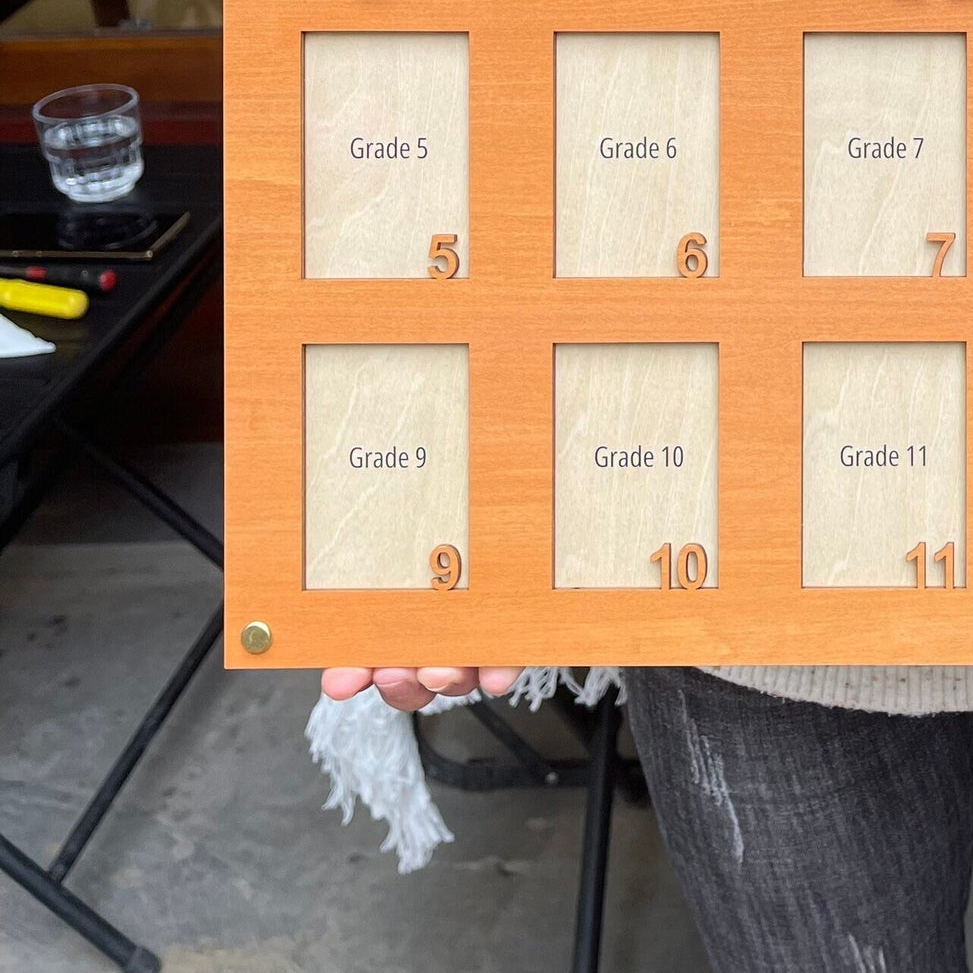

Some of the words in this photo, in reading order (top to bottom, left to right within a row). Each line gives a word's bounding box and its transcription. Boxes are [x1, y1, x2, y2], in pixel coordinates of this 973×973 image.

[350, 137, 411, 159] Grade
[416, 137, 428, 159] 5
[599, 137, 660, 159] Grade
[665, 137, 677, 159] 6
[847, 137, 907, 160] Grade
[913, 137, 924, 159] 7
[427, 233, 460, 279] 5
[676, 232, 708, 278] 6
[926, 232, 956, 277] 7
[349, 446, 409, 469] Grade
[415, 446, 427, 469] 9
[594, 445, 654, 468] Grade
[662, 445, 684, 468] 10
[840, 445, 900, 467] Grade
[907, 445, 928, 467] 11
[429, 544, 462, 590] 9
[649, 543, 708, 589] 10
[905, 542, 956, 588] 11
